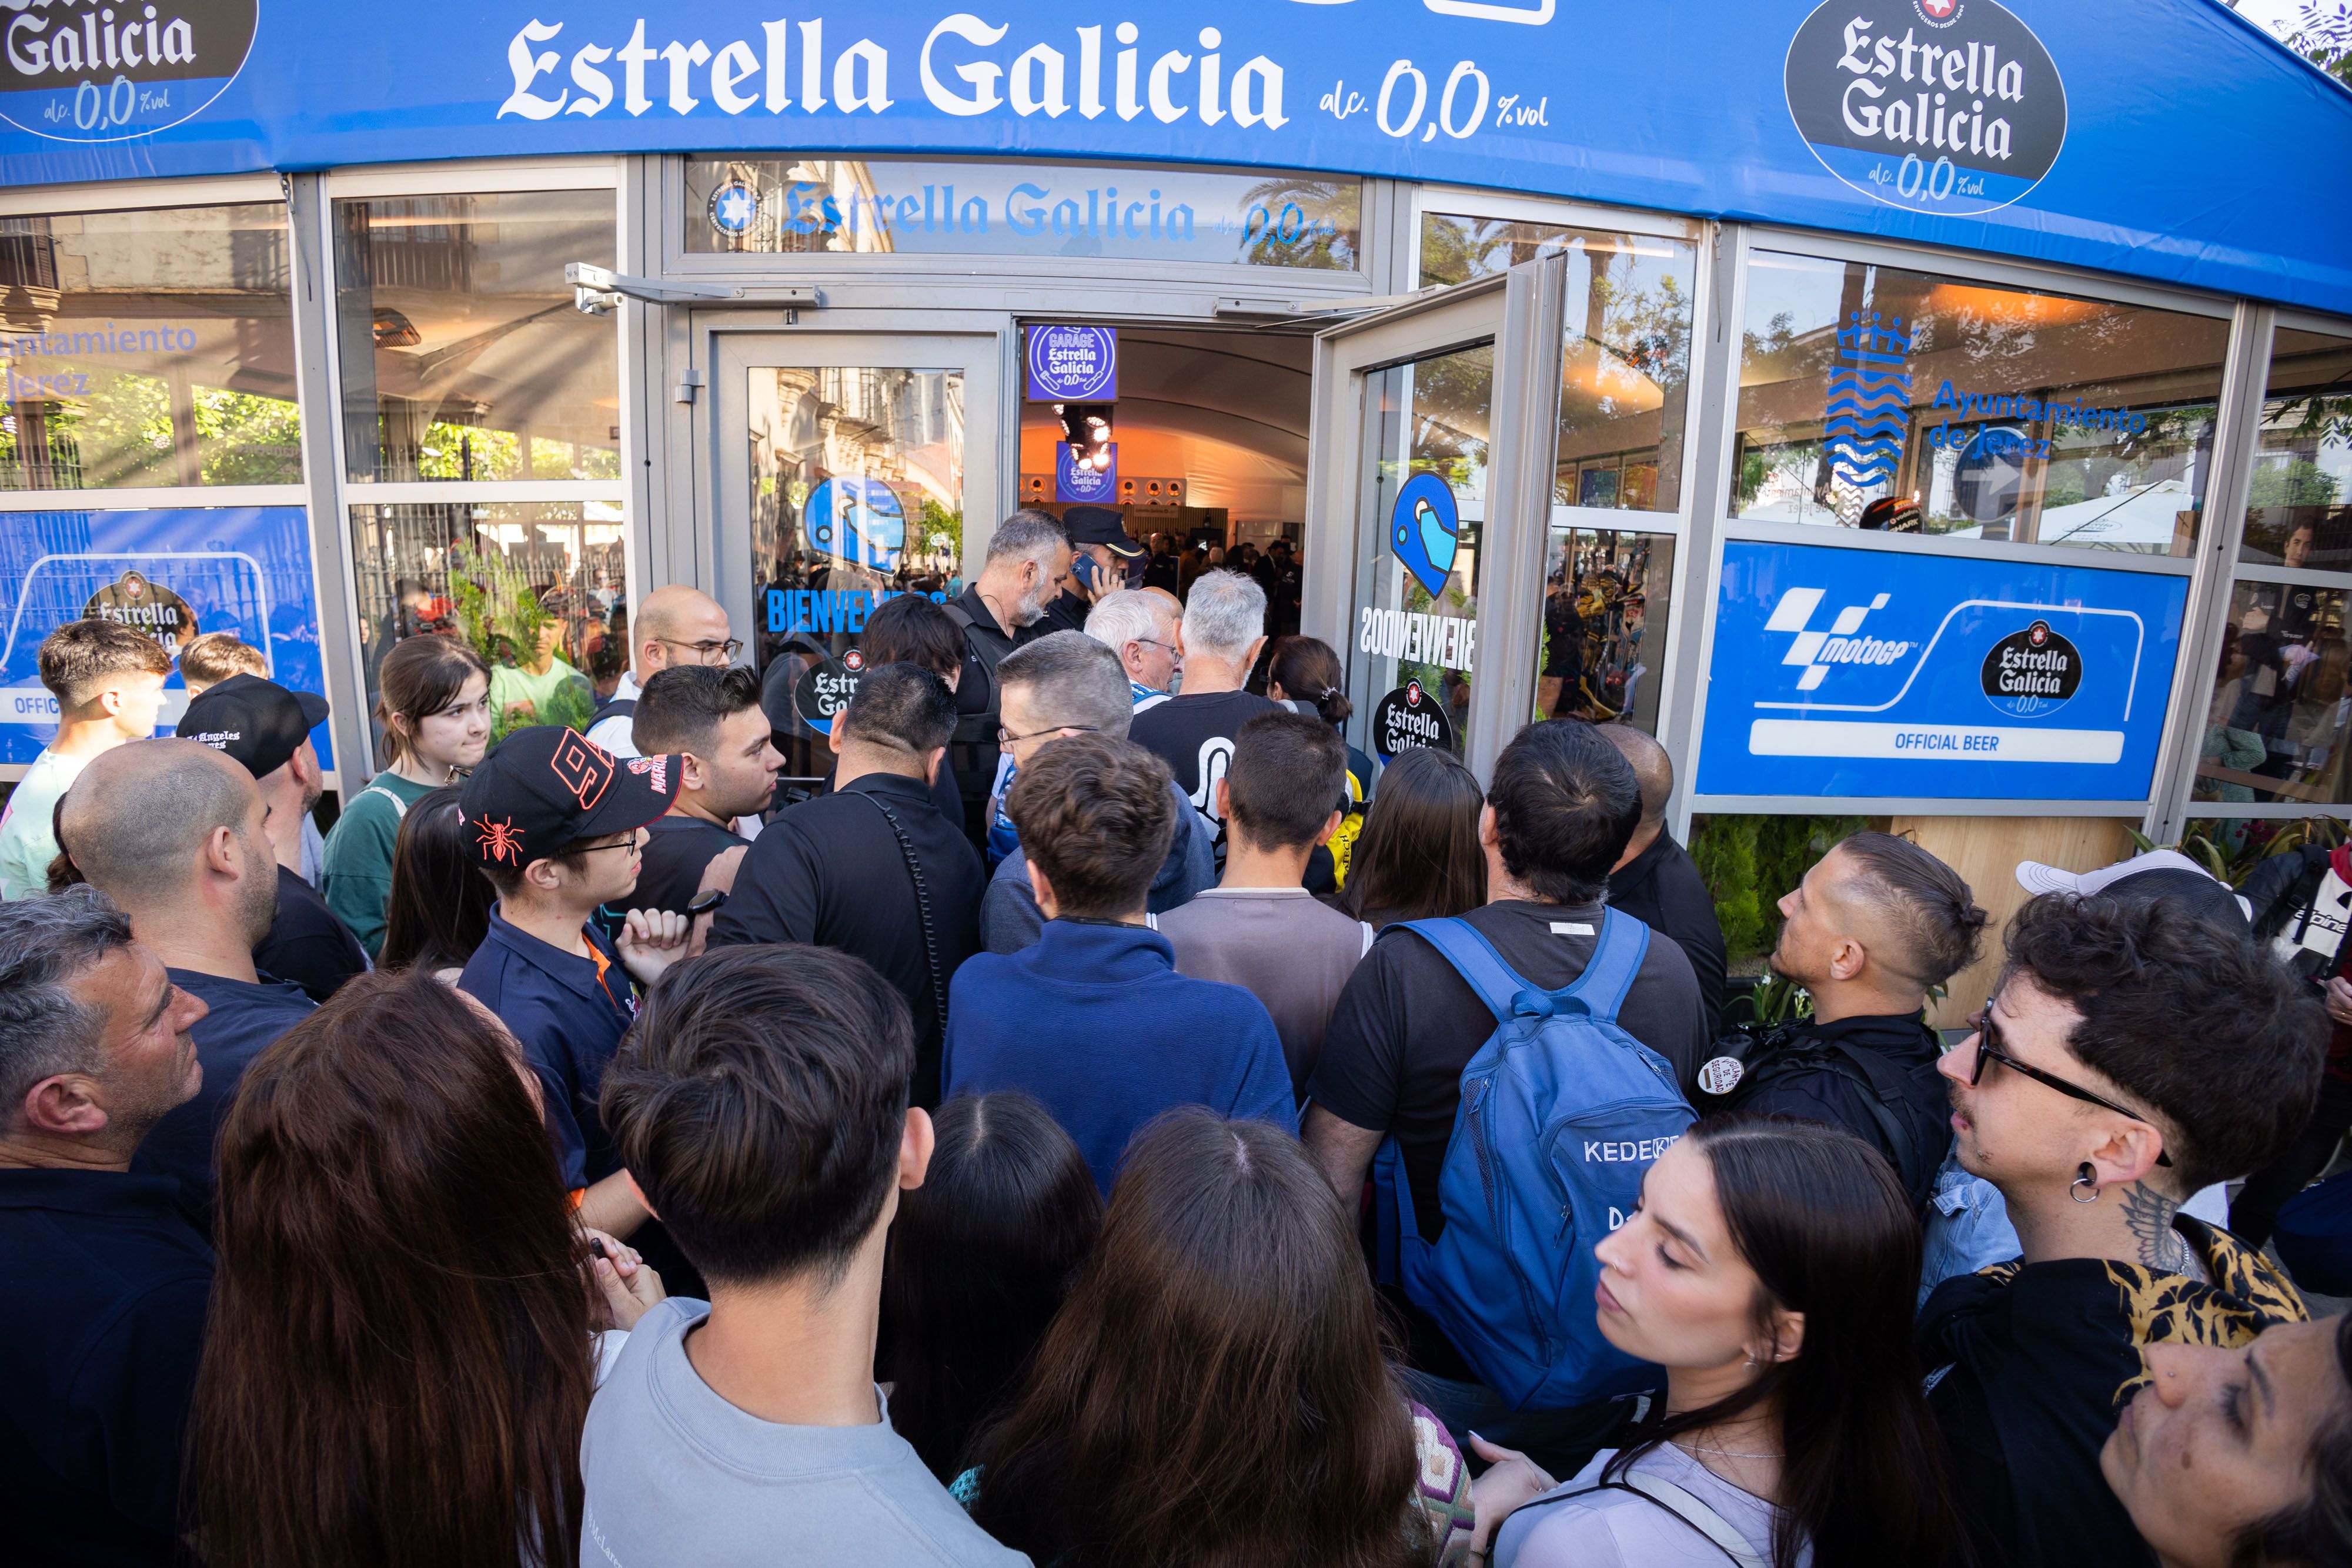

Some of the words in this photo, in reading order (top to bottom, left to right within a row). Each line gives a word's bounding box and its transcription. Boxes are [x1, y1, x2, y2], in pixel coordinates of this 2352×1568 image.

[1940, 18, 1957, 28] DESDE
[7, 5, 196, 75] Galicia
[1836, 16, 2024, 103] Estrella
[496, 18, 894, 120] Estrella
[920, 14, 1289, 131] Galicia
[1319, 80, 1369, 119] alc.
[1376, 59, 1490, 142] 0,0
[44, 99, 71, 123] alc.
[74, 75, 136, 131] 0,0
[1842, 78, 2012, 161] Galicia
[1868, 162, 1894, 185] alc.
[1897, 153, 1956, 202] 0,0
[781, 180, 992, 235] Estrella
[1005, 183, 1196, 242] Galicia
[1243, 202, 1304, 248] 0,0
[1048, 333, 1095, 347] GARAGE
[1048, 348, 1096, 361] Estrella
[1049, 360, 1094, 374] Galicia
[1932, 379, 2146, 434] Ayuntamiento
[1929, 419, 1966, 450] de
[1972, 423, 2051, 460] Jerez
[1071, 476, 1101, 485] Galicia
[767, 589, 947, 633] BIENVE
[1999, 646, 2068, 671] Estrella
[814, 672, 859, 694] Estr
[1999, 669, 2062, 694] Galicia
[15, 697, 59, 714] OFFIC
[2016, 694, 2039, 713] 0,0
[199, 731, 240, 742] Angeles
[1385, 703, 1439, 740] Estrella
[1895, 733, 1959, 750] OFFICIAL
[1963, 735, 1999, 751] BEER
[1711, 1060, 1724, 1092] SEGURIDAD
[1721, 1058, 1741, 1088] VIGILANTE
